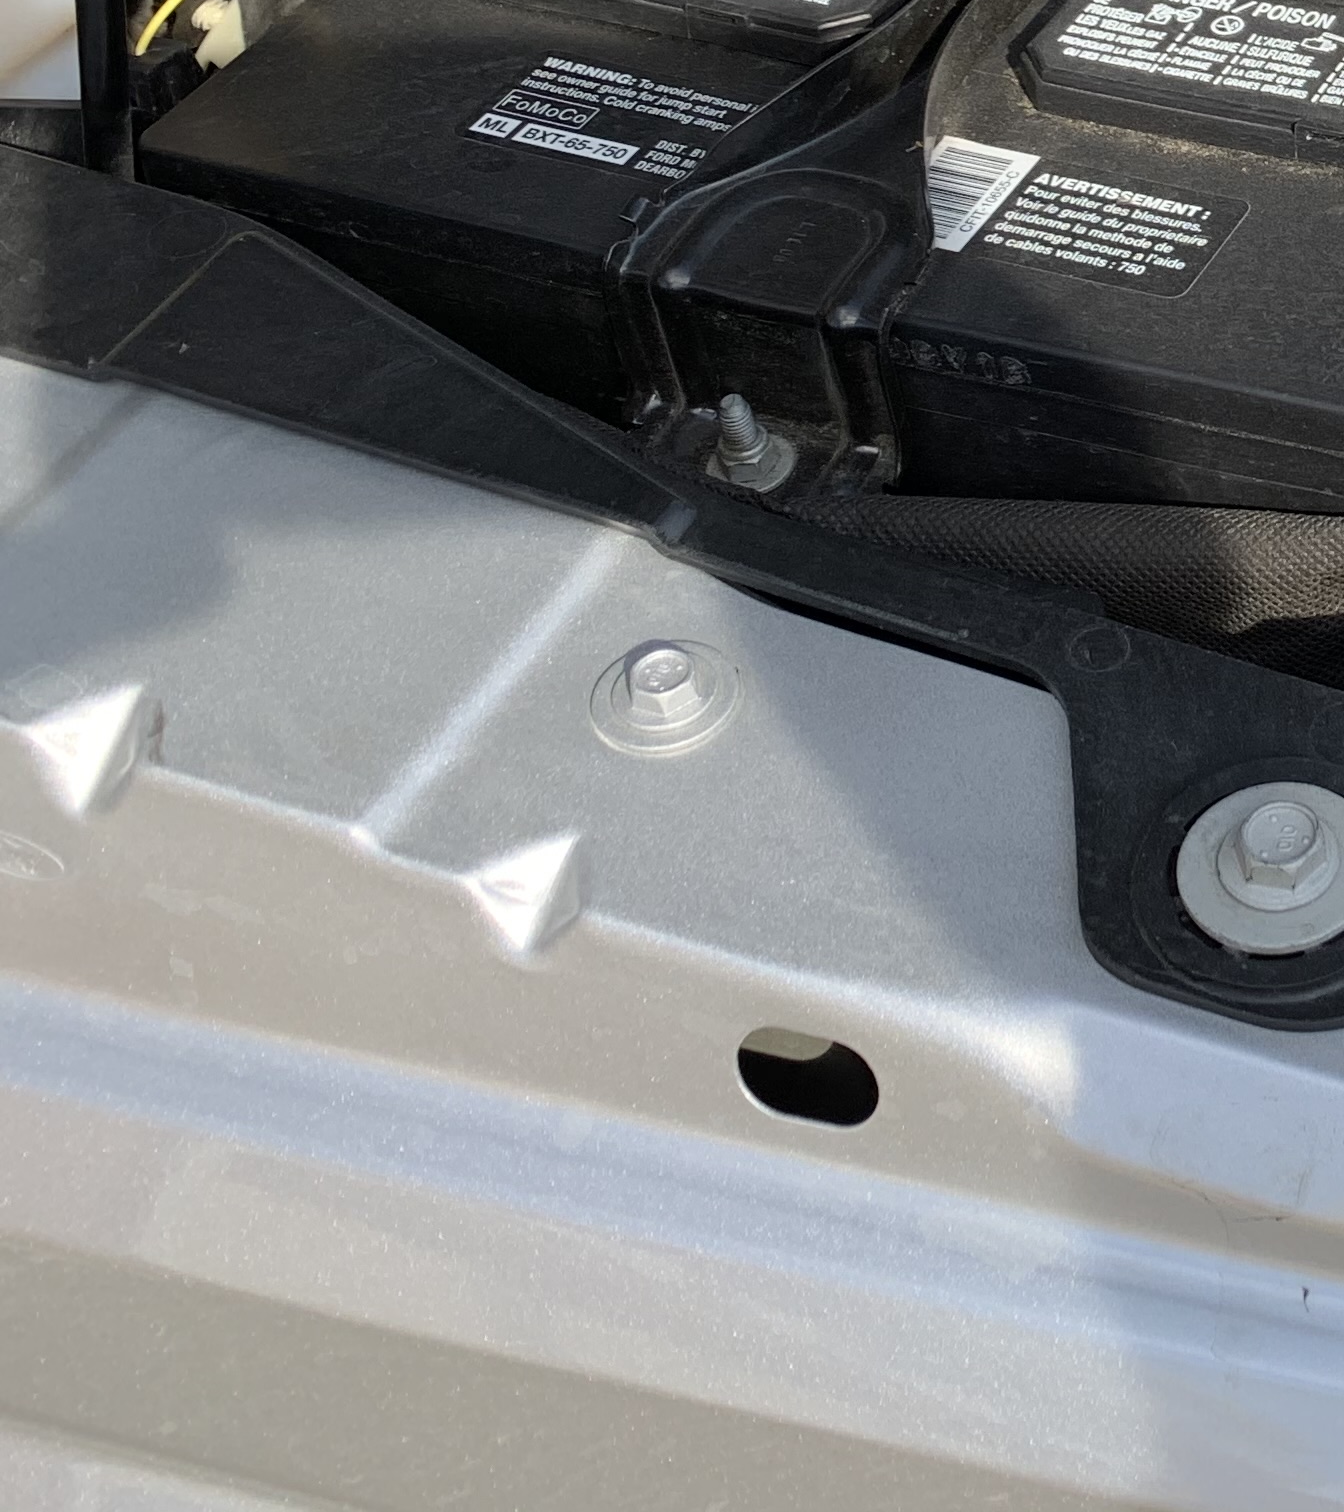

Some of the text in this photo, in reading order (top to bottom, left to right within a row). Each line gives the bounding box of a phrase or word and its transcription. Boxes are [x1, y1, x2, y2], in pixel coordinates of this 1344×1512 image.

[1251, 1, 1336, 29] POISON
[1187, 35, 1241, 53] AUCUNE
[520, 76, 599, 102] instructions.
[602, 95, 637, 109] Cold
[634, 104, 695, 124] cranking
[531, 68, 727, 118] see owner guide for jump start
[543, 56, 637, 85] WARNING:
[637, 78, 654, 89] To
[653, 84, 694, 97] avoid
[688, 92, 752, 111] personal
[501, 94, 587, 123] FoMoCo
[477, 117, 628, 159] ML BXT-65-750
[644, 150, 681, 165] FORD
[654, 139, 687, 155] DIST.
[633, 160, 686, 179] DEARBO
[1023, 184, 1202, 232] Pour eviter des blessures.
[1032, 173, 1202, 217] AVERTISSEMENT
[1003, 209, 1174, 253] quidonne la methode de
[1015, 196, 1208, 246] Voir le guide du proprietaire
[983, 232, 1004, 244] de
[1004, 238, 1053, 255] cables
[1054, 248, 1108, 267] volants
[1117, 261, 1146, 275] 750
[993, 220, 1185, 269] demarrage secours a l'aide
